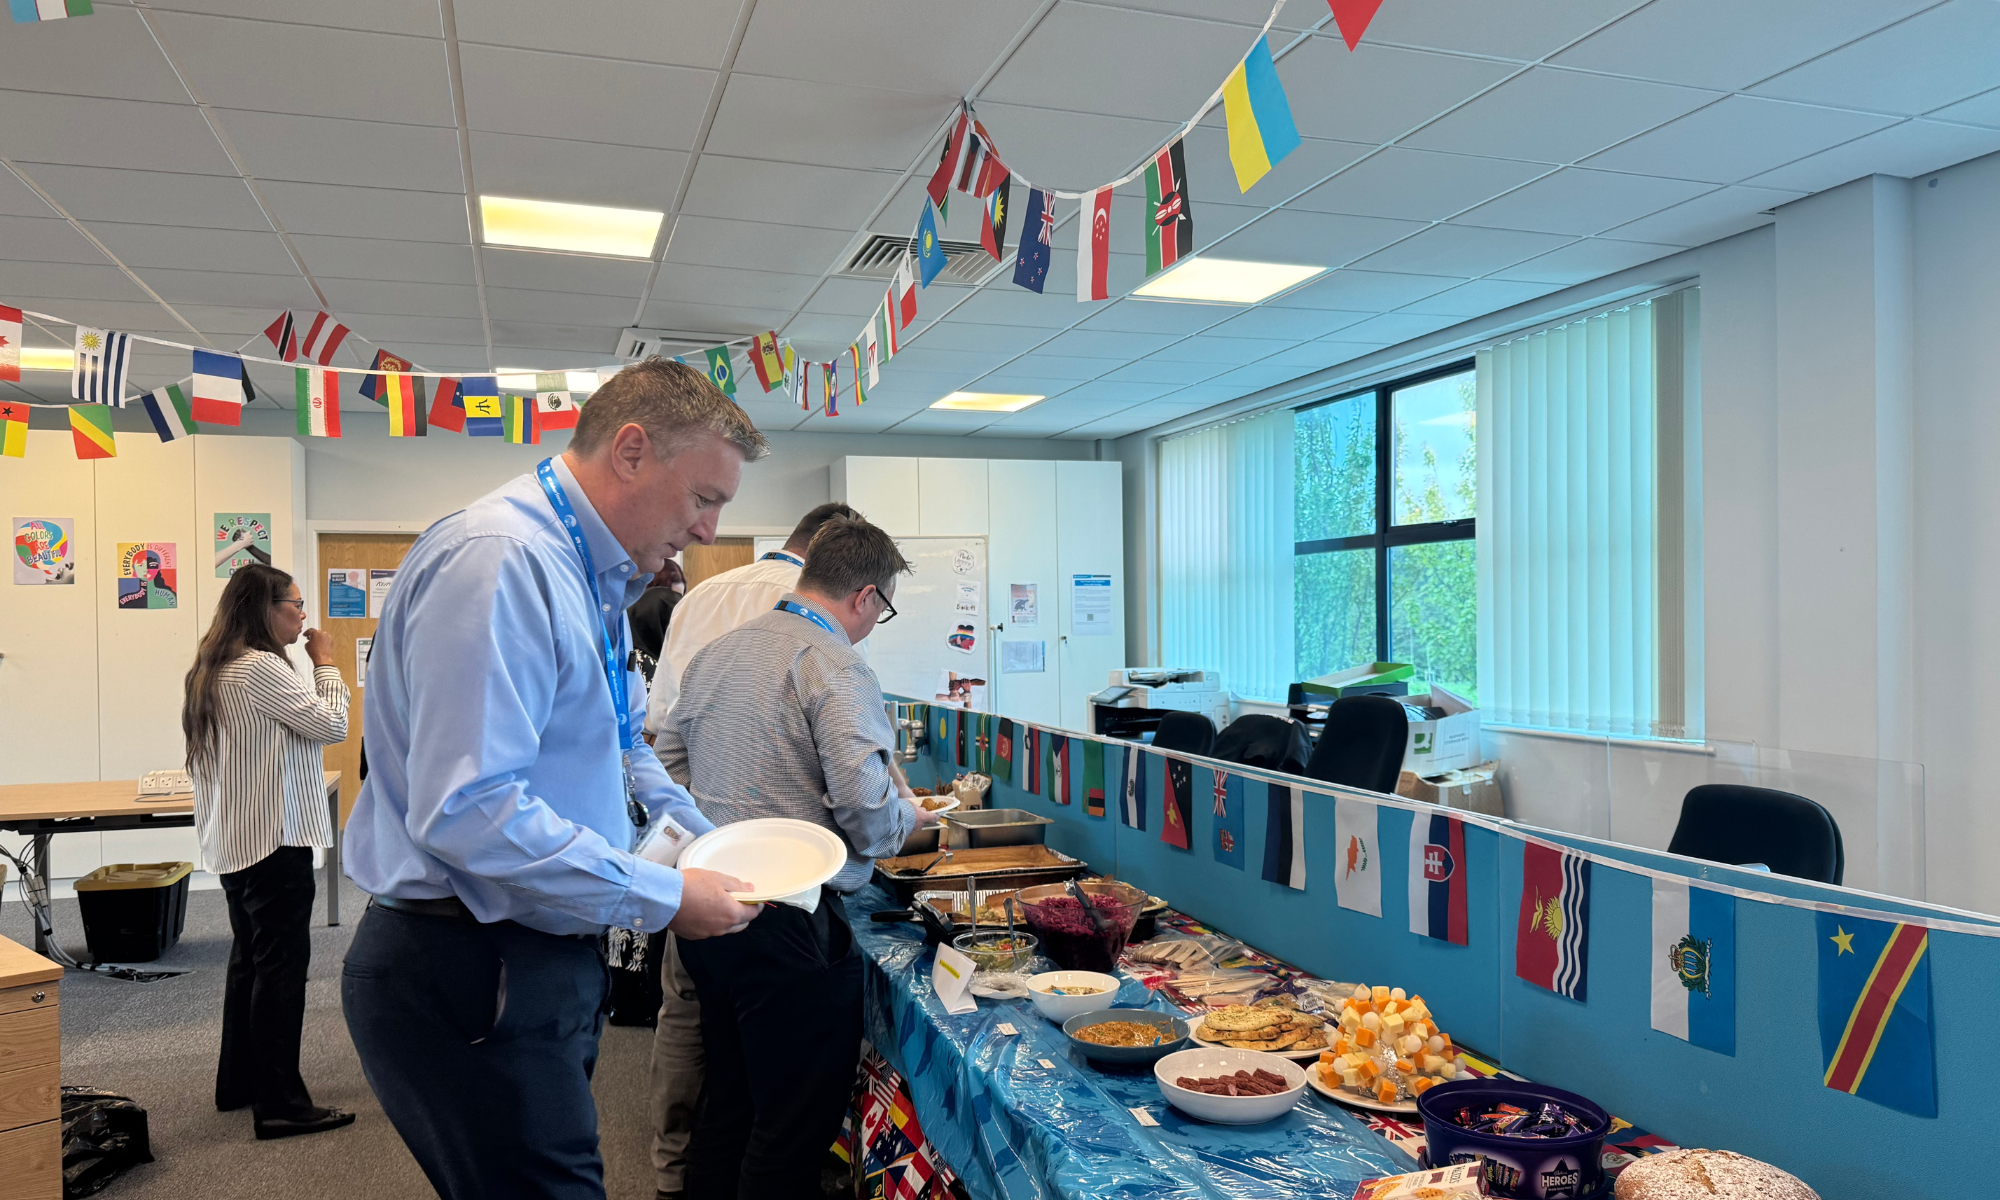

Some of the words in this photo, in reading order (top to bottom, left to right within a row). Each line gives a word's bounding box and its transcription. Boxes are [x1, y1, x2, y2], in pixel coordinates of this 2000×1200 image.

[30, 521, 46, 530] ALL
[216, 524, 230, 541] WE
[228, 516, 269, 541] RESPECT
[24, 531, 54, 543] COLORS
[36, 541, 50, 551] ARE
[122, 543, 146, 576] EVERYBODY
[231, 558, 255, 567] EACH
[119, 587, 147, 605] EVERYBODY
[154, 589, 176, 607] HUMAN
[1541, 1172, 1578, 1188] HEROES
